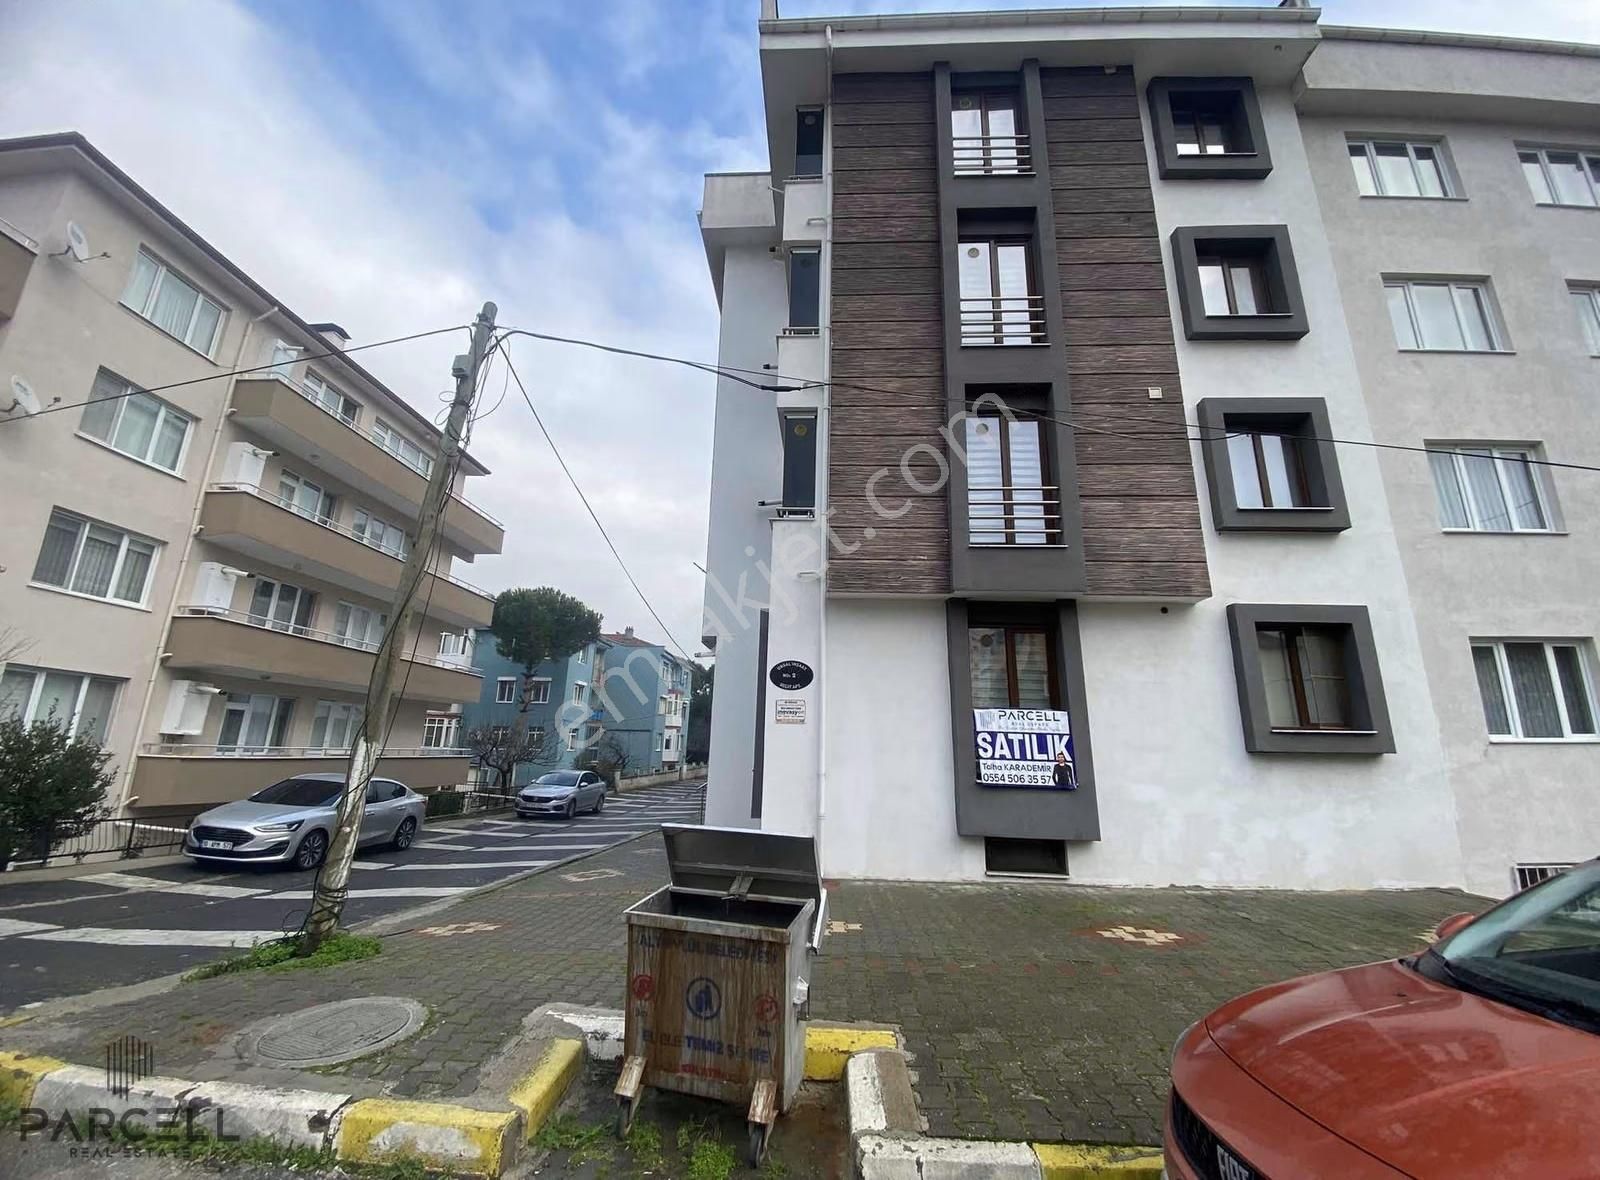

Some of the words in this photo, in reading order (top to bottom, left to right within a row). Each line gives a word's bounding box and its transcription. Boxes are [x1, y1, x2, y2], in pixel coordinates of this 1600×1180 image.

[998, 710, 1061, 722] PARCELL
[976, 732, 1073, 761] SATILIK
[982, 762, 1003, 771] Talha
[1003, 762, 1052, 773] KARADEMİR
[982, 773, 1005, 783] 0554
[1007, 774, 1026, 784] 506
[1027, 775, 1039, 784] 35
[1041, 775, 1052, 785] 57
